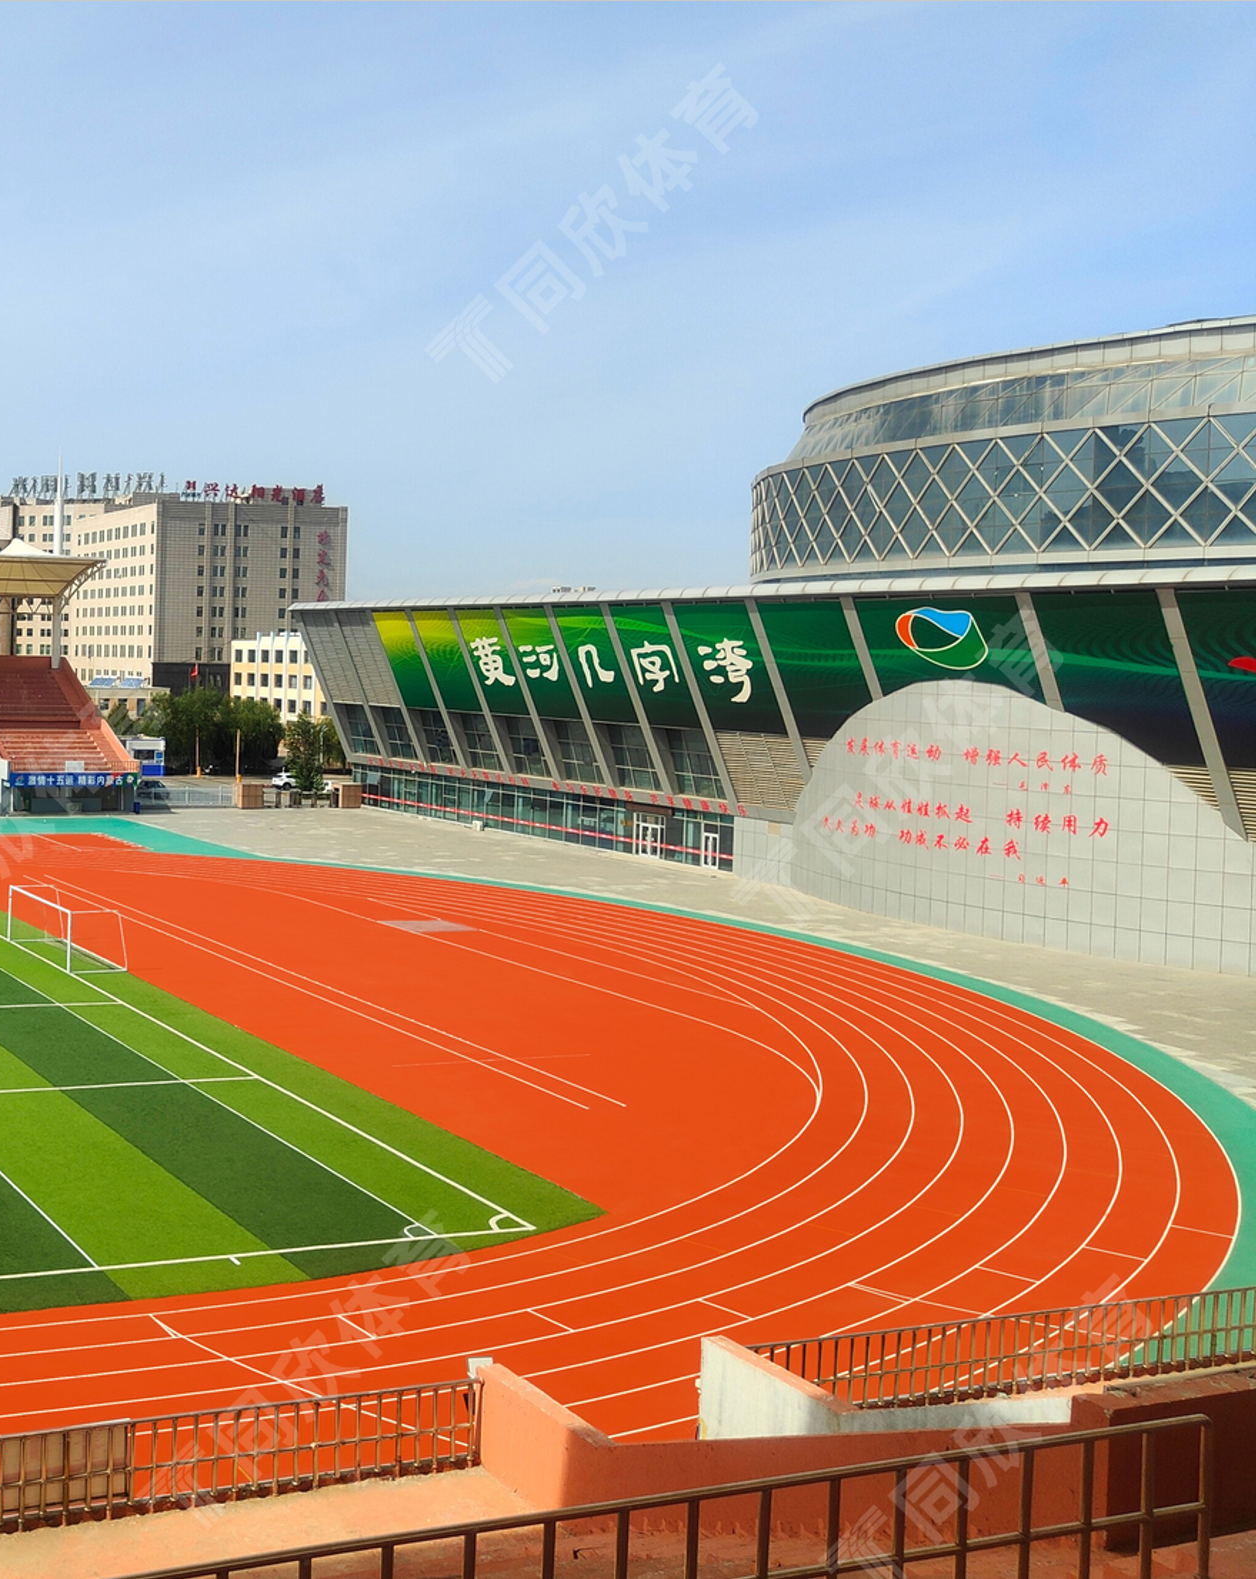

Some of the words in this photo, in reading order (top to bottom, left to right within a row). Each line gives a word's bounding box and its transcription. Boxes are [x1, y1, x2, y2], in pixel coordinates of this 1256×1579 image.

[470, 636, 754, 703] 黄河几字湾
[846, 737, 942, 762] 发展体育运动
[964, 746, 1108, 777] 增强人民体质
[854, 792, 973, 824] 足球从娃娃抓起
[1005, 809, 1109, 838] 持续用力
[822, 816, 877, 838] 久久为功
[899, 829, 1022, 860] 功成不必在我
